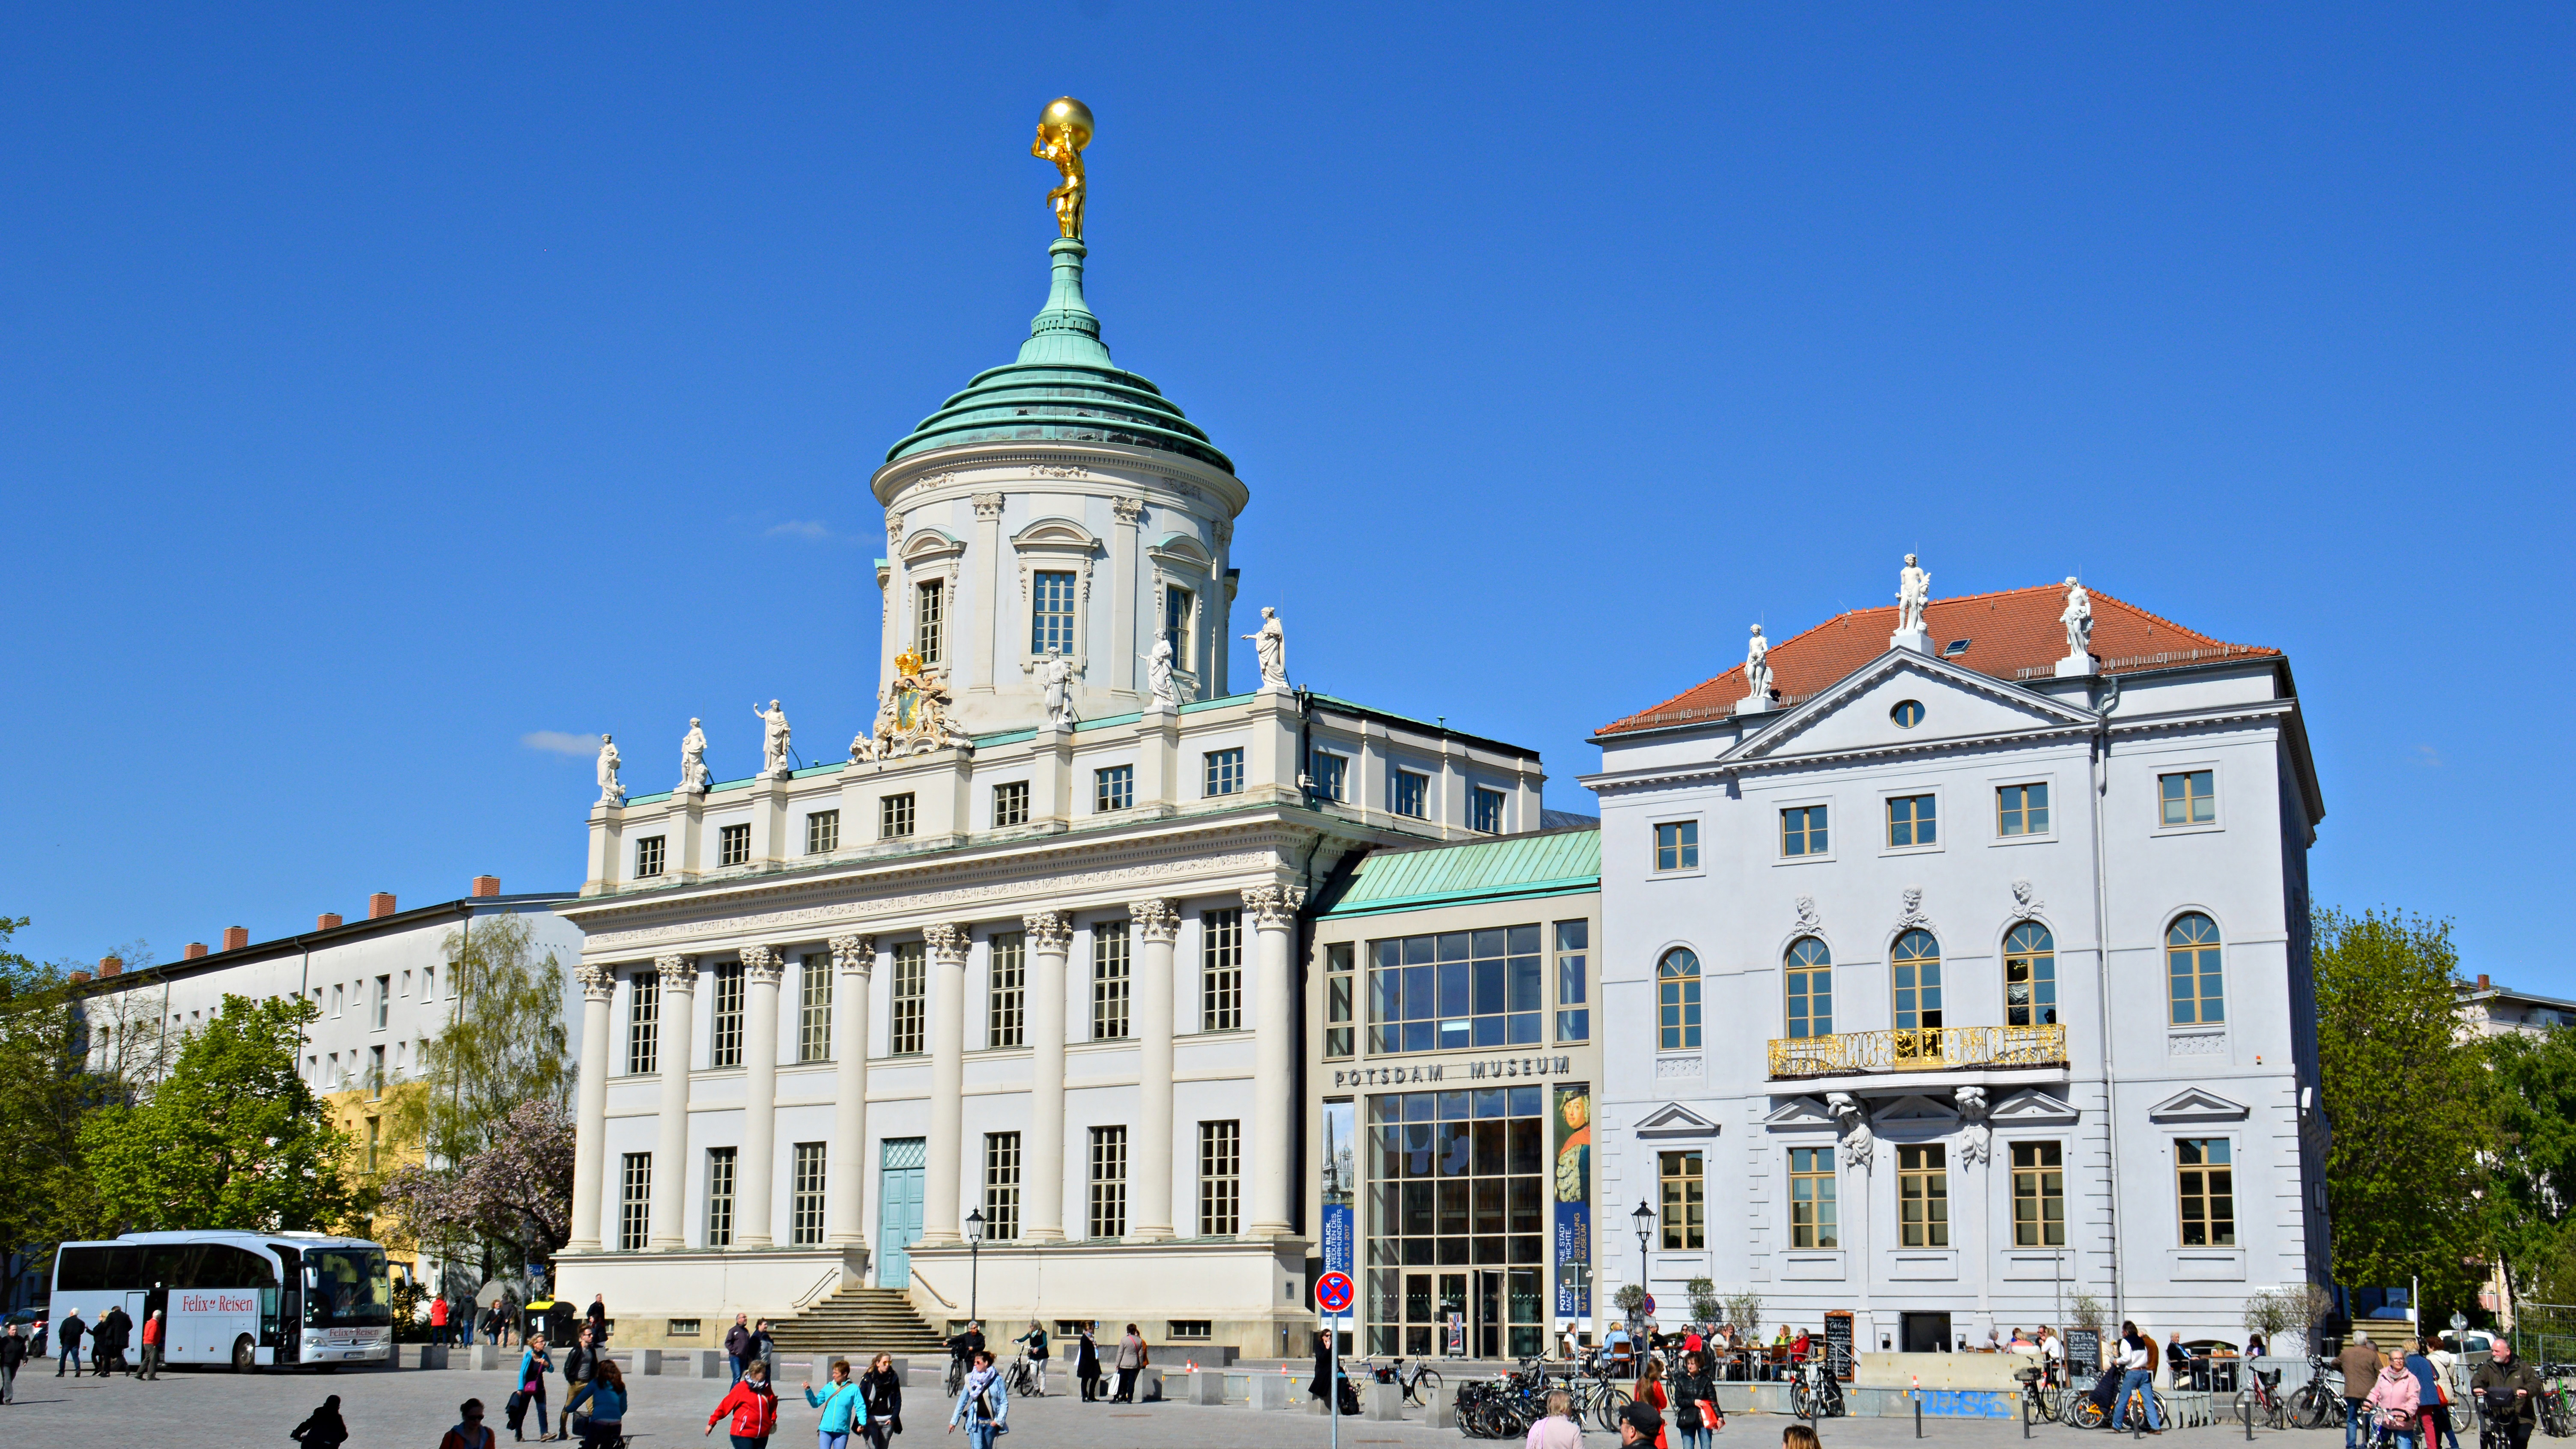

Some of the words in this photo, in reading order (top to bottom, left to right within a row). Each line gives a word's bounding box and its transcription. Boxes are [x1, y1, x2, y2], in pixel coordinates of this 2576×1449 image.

[1335, 1064, 1443, 1088] POTSDAM
[1470, 1055, 1570, 1079] MUSEUM
[182, 1295, 209, 1311] Felix
[218, 1295, 253, 1311] Reisen
[329, 1328, 349, 1336] Felix
